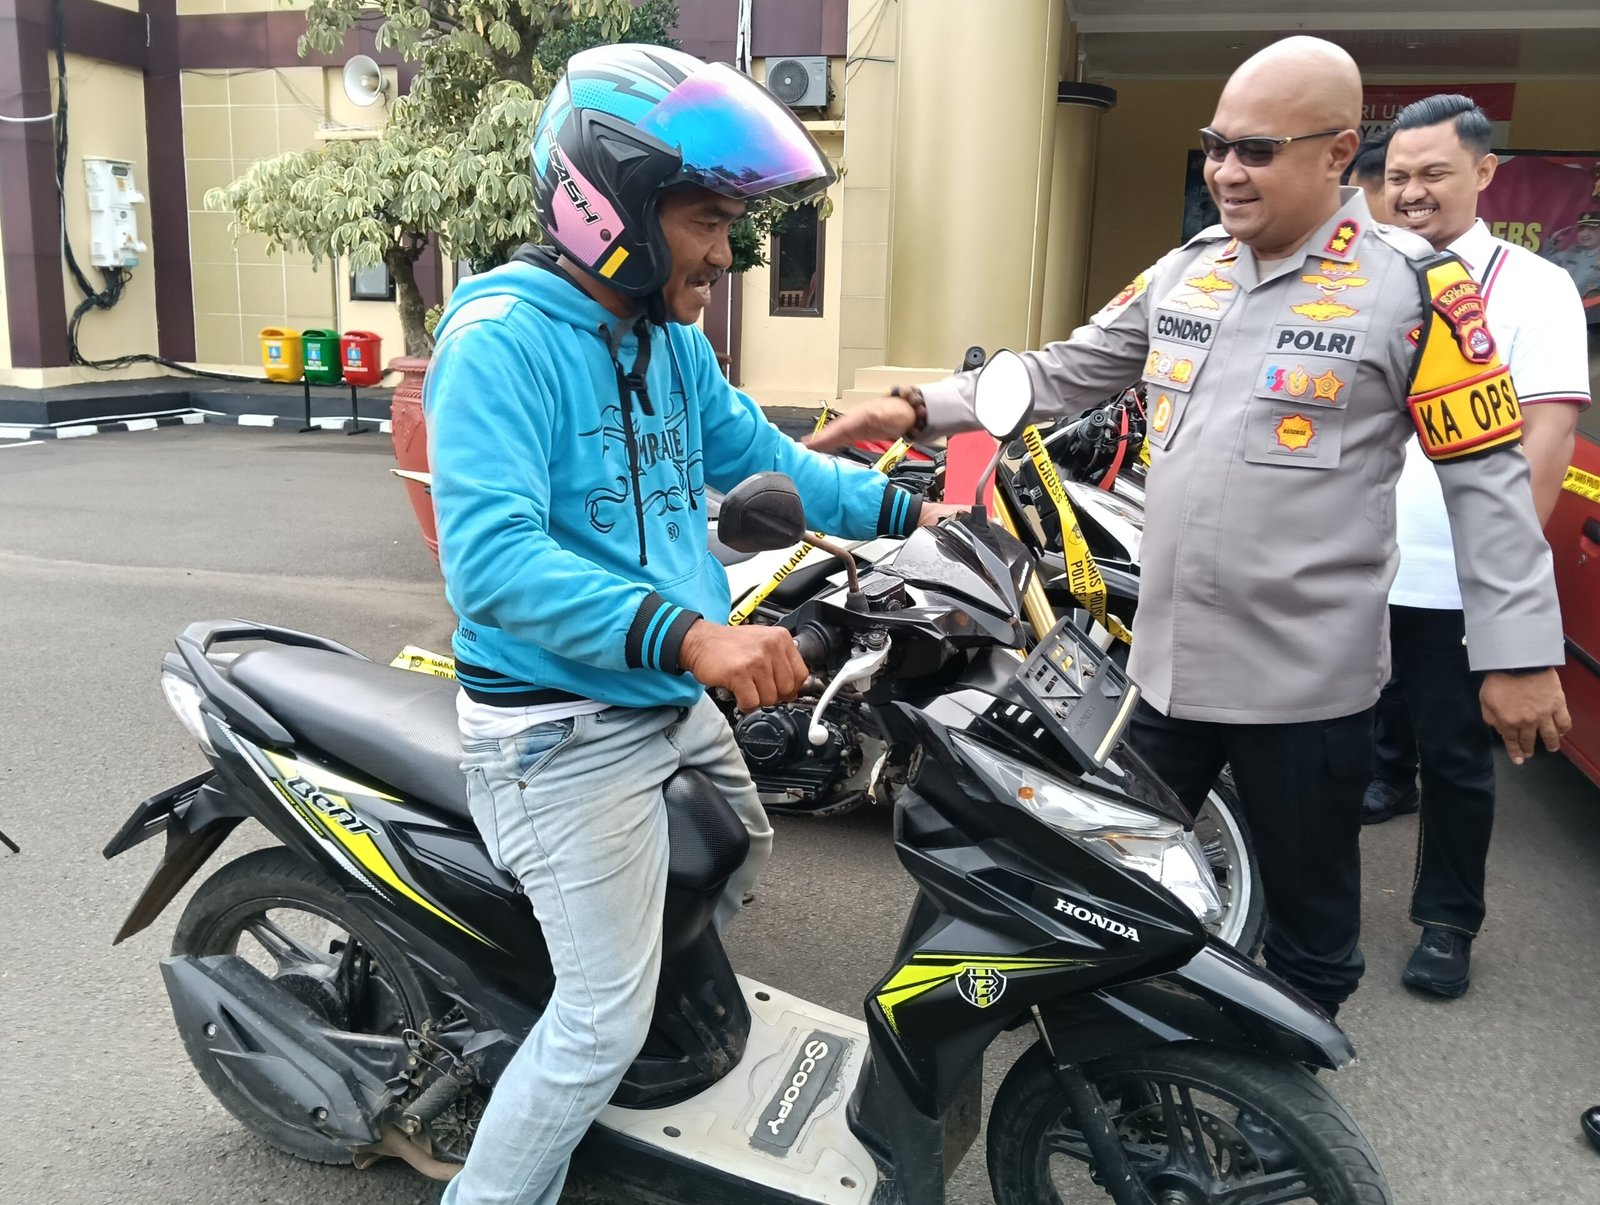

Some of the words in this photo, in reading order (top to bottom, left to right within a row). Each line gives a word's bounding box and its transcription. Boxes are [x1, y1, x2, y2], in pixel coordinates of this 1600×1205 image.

[1486, 221, 1541, 253] ERS
[1157, 315, 1212, 343] CONDRO
[1276, 329, 1355, 355] POLRI
[1420, 400, 1462, 446] KA
[1469, 379, 1516, 431] OPS
[1024, 431, 1044, 458] NOT
[1038, 460, 1063, 503] CROSS
[1084, 551, 1101, 588] GARIS
[1054, 898, 1140, 942] HONDA
